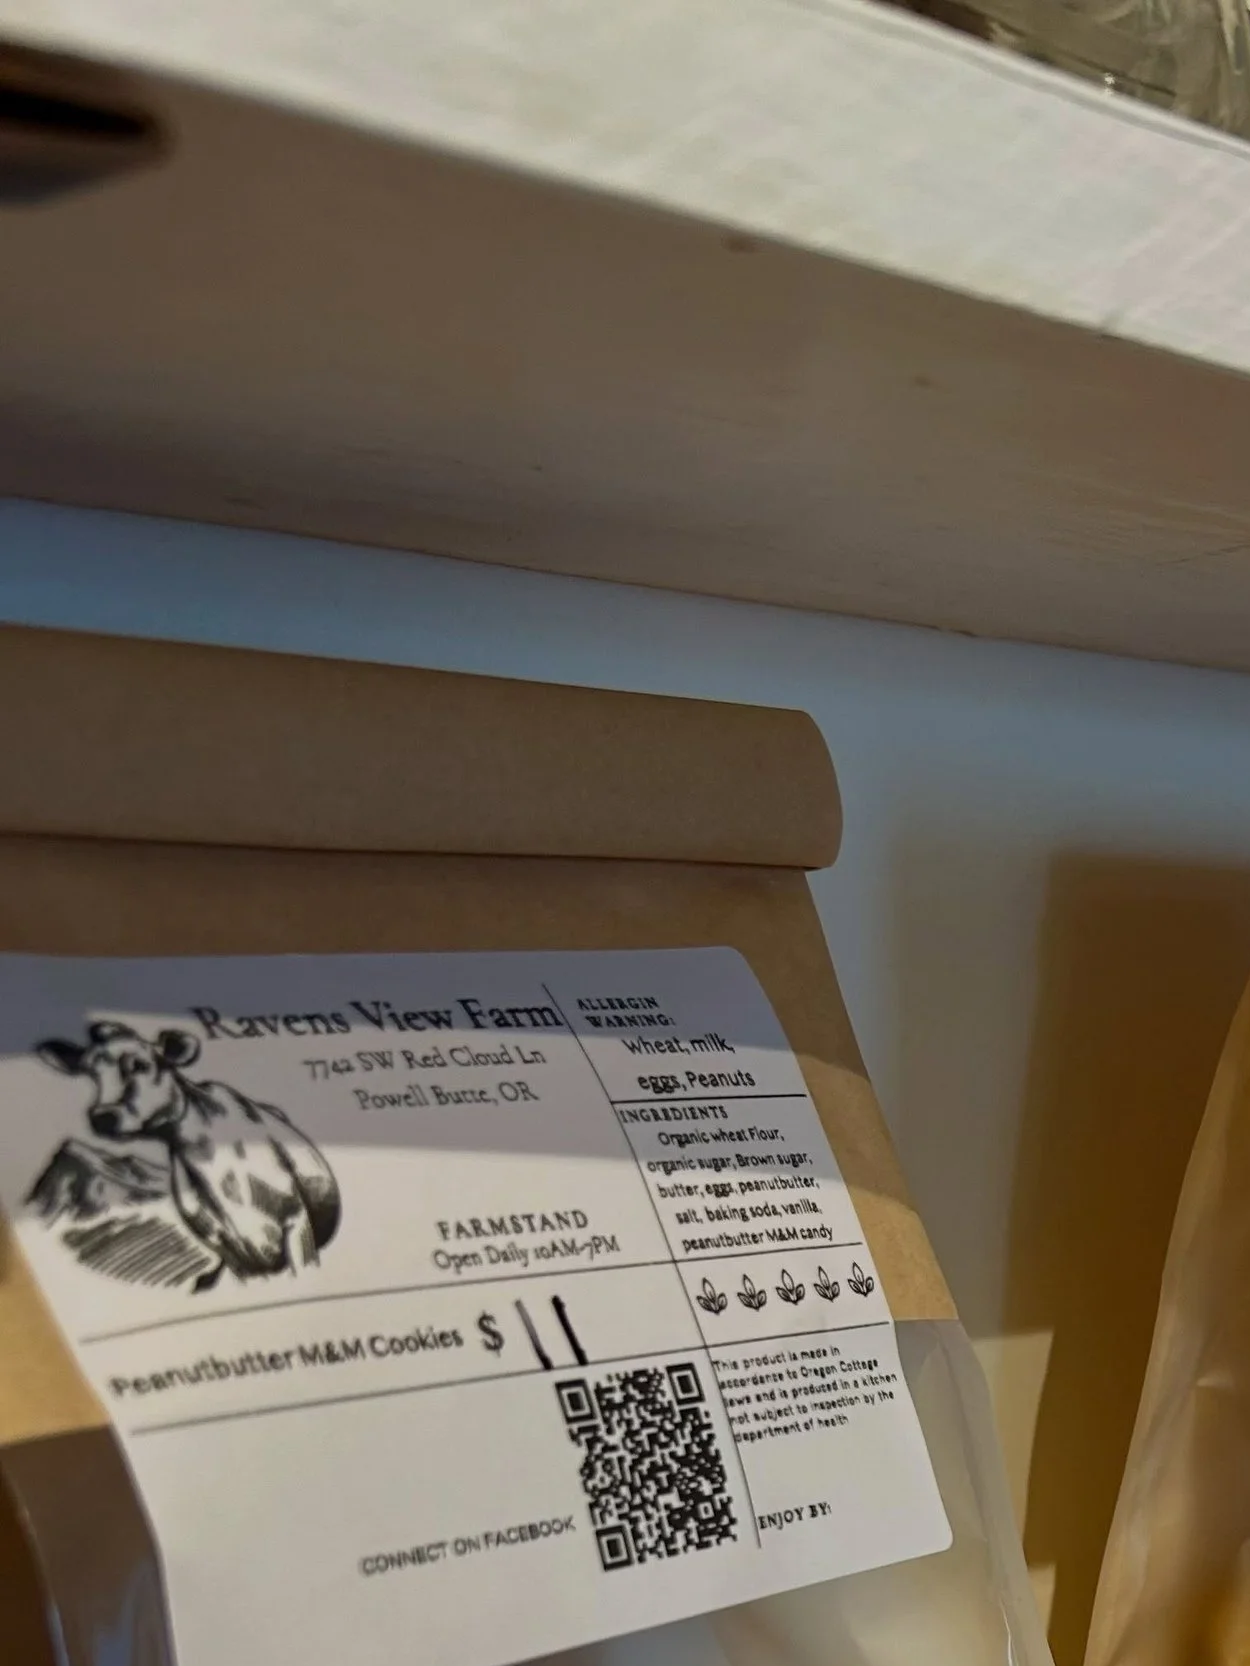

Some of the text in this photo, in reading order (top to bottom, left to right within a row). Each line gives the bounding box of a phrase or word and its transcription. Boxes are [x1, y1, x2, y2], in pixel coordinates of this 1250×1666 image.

[190, 998, 564, 1040] Ravens View Farm
[691, 1032, 736, 1054] milk,
[353, 1050, 395, 1072] SW
[401, 1046, 447, 1070] Red
[449, 1045, 512, 1068] Cloud
[513, 1045, 546, 1066] Ln
[353, 1084, 430, 1111] Powell
[498, 1080, 539, 1102] OR
[637, 1070, 756, 1095] eggs, Peanuts
[619, 1105, 729, 1124] INGREDIENTS
[658, 1125, 785, 1149] Organic wheat Flour,
[647, 1150, 813, 1176] organic sugar, Brown sugar,
[657, 1182, 705, 1200] butter,
[738, 1175, 820, 1195] peanutbutter,
[435, 1208, 590, 1241] FARMSTAND
[675, 1207, 704, 1225] salt,
[706, 1204, 749, 1222] baking
[749, 1200, 782, 1218] soda,
[681, 1222, 833, 1254] peanutbutter M&M candy
[432, 1234, 621, 1275] Open Daily 10AM-7PM
[108, 1347, 295, 1400] Peanutbutter
[297, 1338, 368, 1368] M&M
[368, 1324, 464, 1359] Cookies
[743, 1351, 786, 1370] product
[800, 1362, 838, 1380] Oregon
[839, 1357, 879, 1373] Cottage
[755, 1390, 776, 1403] and
[791, 1380, 839, 1397] produced
[862, 1372, 898, 1388] kitchen
[753, 1404, 795, 1422] subject
[797, 1402, 808, 1415] to
[811, 1393, 861, 1412] inspection
[864, 1391, 876, 1406] by
[877, 1388, 895, 1402] the
[734, 1412, 850, 1444] department of health
[757, 1501, 833, 1531] ENJOY BY:
[360, 1514, 577, 1577] CONNECT ON FACEBOOK
